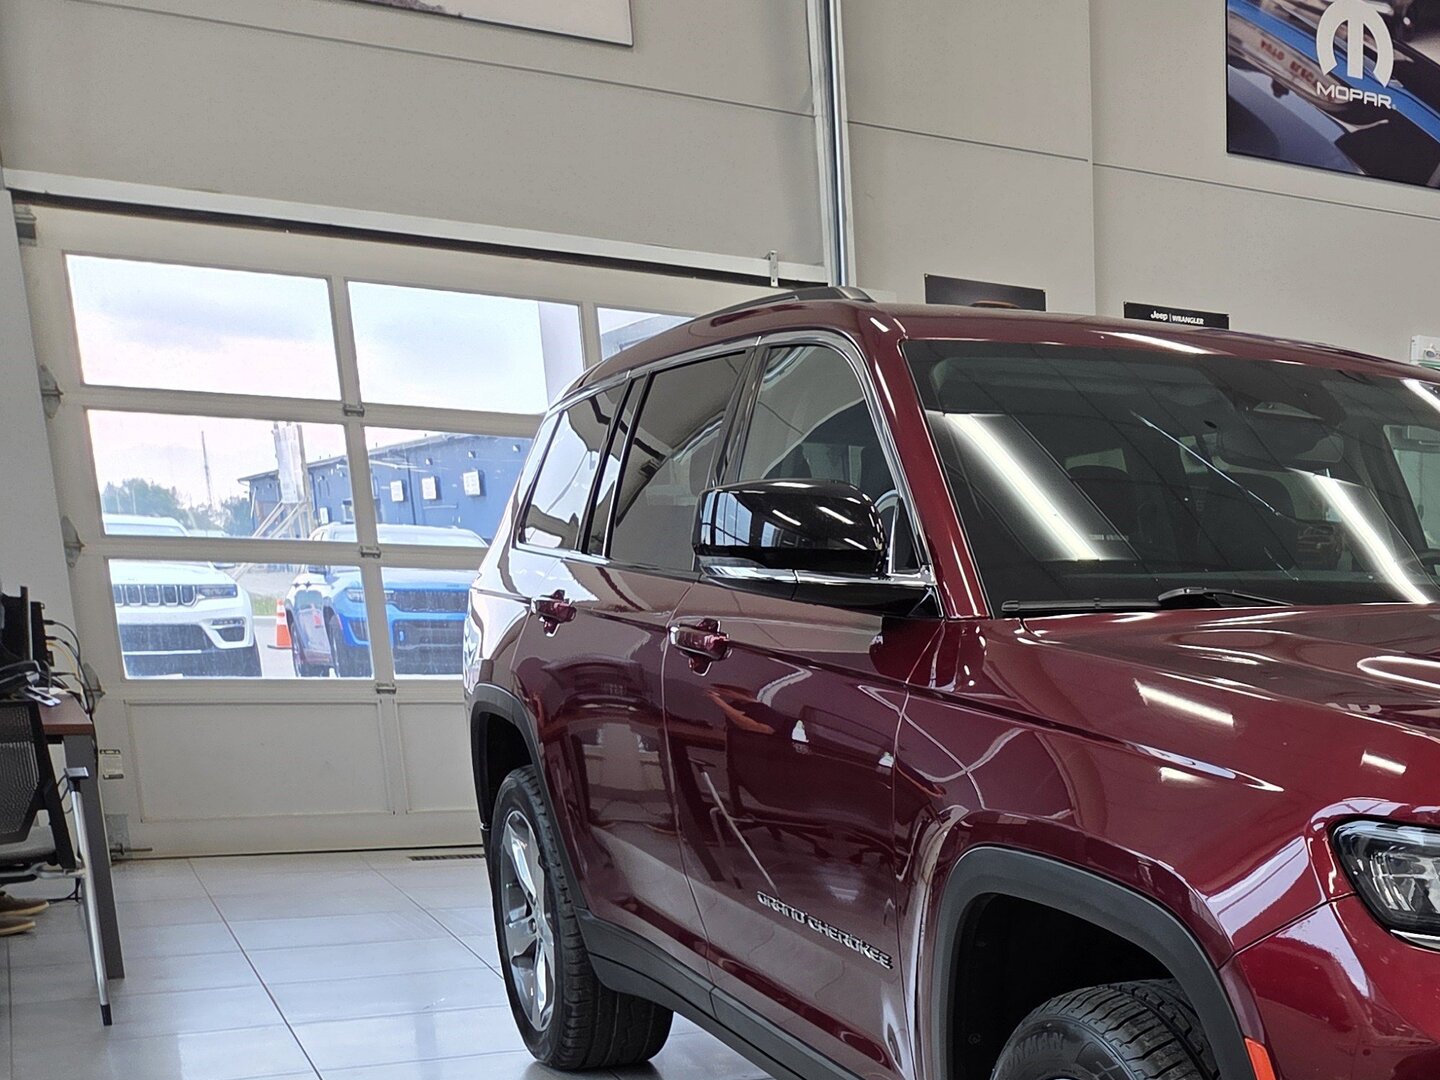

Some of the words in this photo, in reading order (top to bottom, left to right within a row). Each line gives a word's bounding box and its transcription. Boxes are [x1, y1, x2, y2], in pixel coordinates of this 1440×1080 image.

[1150, 310, 1168, 321] Jeep
[1172, 315, 1205, 325] WRANGLER
[757, 891, 806, 924] GRAND
[808, 914, 892, 969] CHEROKEE
